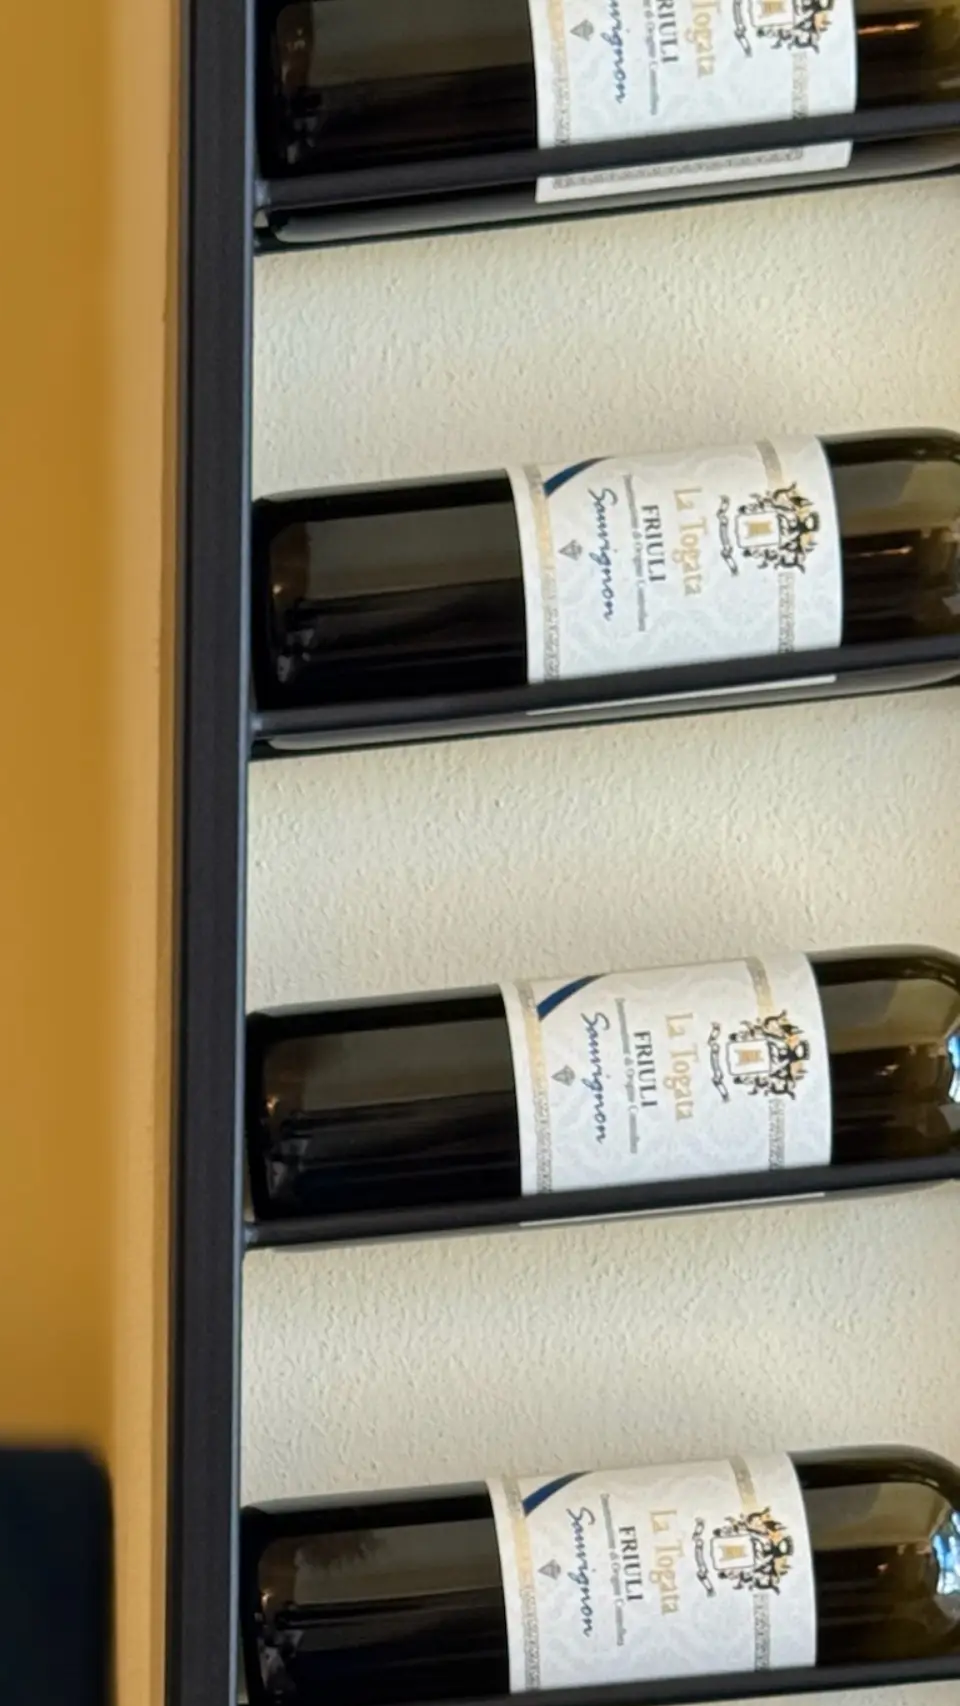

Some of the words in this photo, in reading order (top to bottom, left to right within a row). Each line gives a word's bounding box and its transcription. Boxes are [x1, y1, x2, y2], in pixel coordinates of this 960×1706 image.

[657, 0, 679, 63] RIULI
[673, 488, 702, 510] La
[589, 488, 618, 621] Sauvignon
[641, 505, 665, 582] FRIULI
[672, 518, 708, 598] Togata
[665, 1013, 694, 1037] La
[581, 1012, 610, 1143] Sauvignon
[633, 1031, 656, 1107] FRIULI
[663, 1046, 699, 1121] Togata
[649, 1510, 678, 1533] La
[566, 1507, 596, 1637] Sauvignon
[619, 1526, 643, 1601] FRIULI
[648, 1543, 684, 1615] Togata
